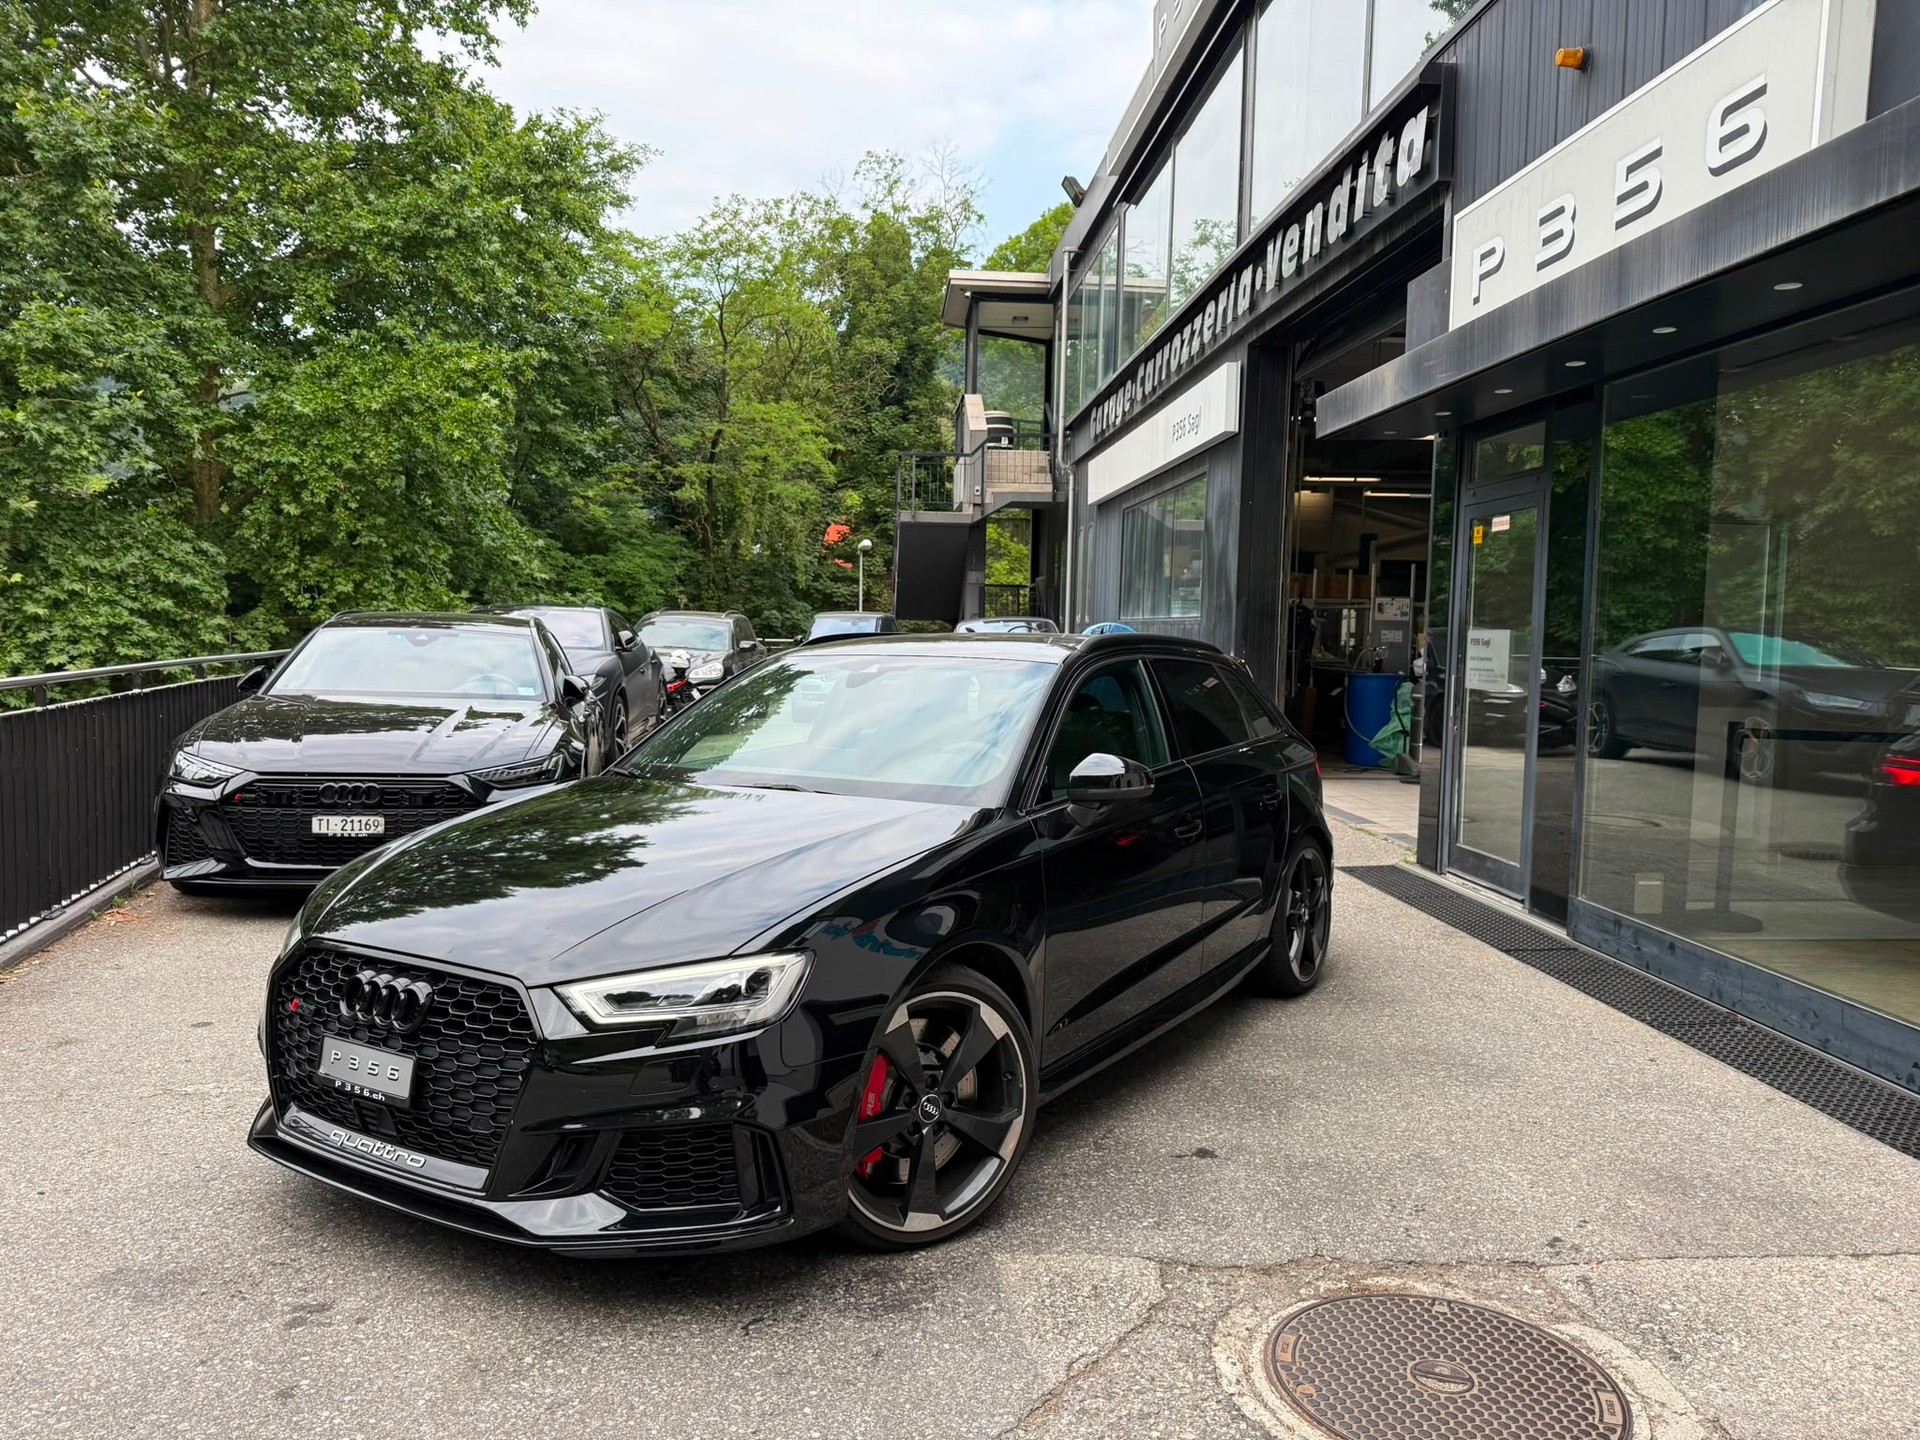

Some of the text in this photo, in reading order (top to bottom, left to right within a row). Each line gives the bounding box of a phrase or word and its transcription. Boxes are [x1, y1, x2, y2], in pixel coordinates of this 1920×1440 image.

[1171, 405, 1202, 444] P356 Sagl
[329, 1129, 427, 1169] quattro
